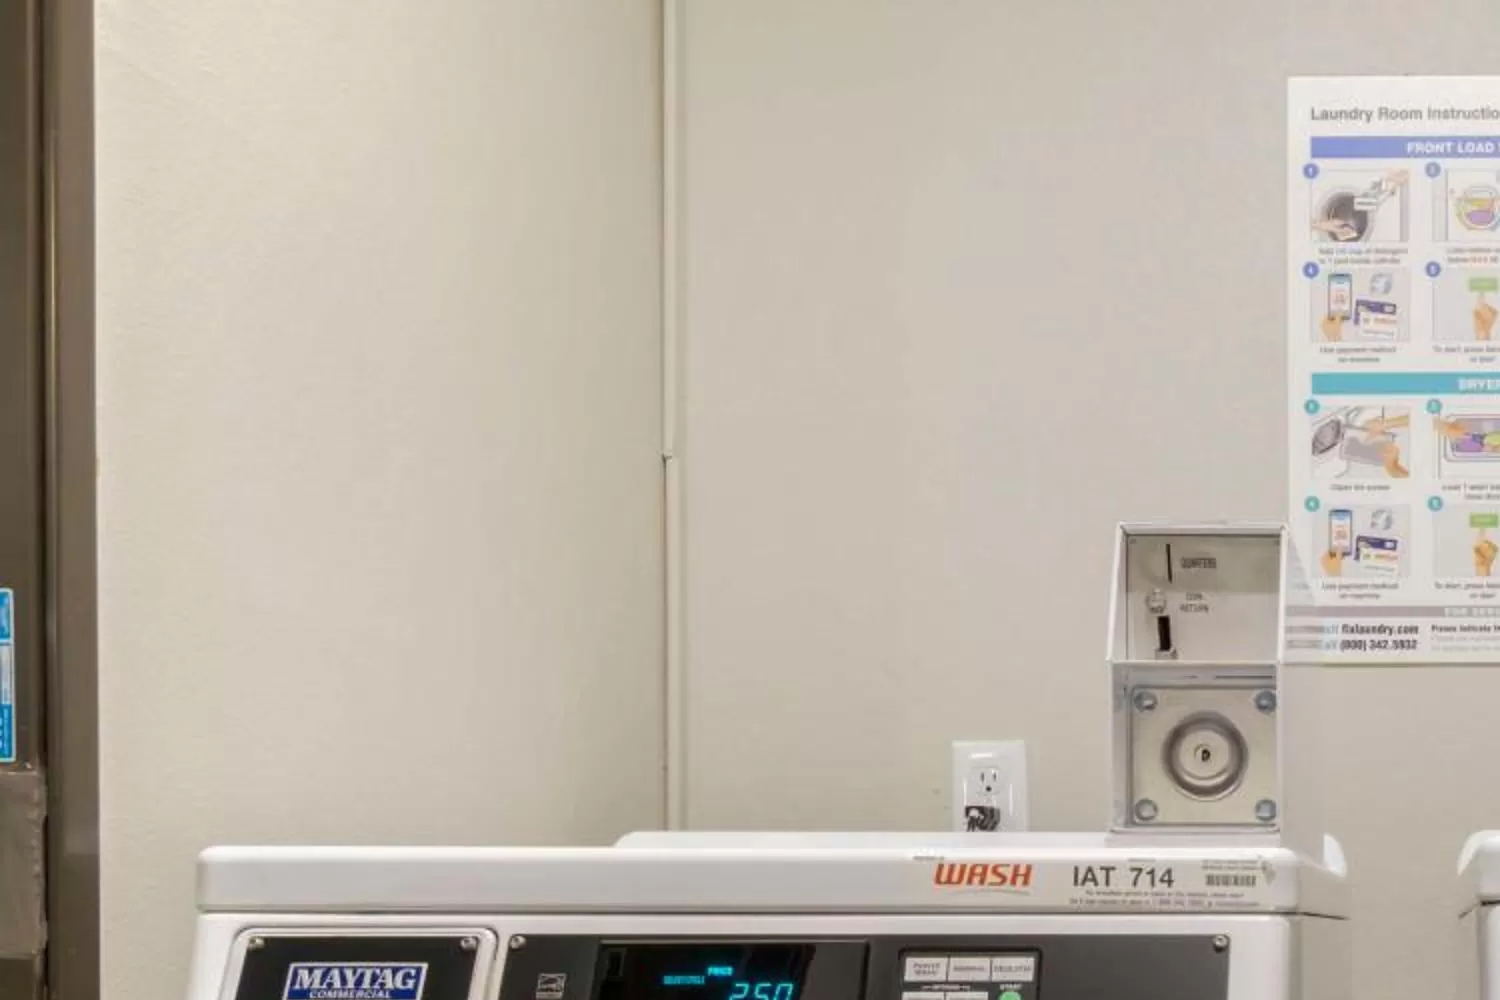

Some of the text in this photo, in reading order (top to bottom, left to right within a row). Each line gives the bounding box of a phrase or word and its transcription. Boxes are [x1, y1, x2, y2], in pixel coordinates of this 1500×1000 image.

[1310, 106, 1372, 123] Laundry
[1377, 107, 1424, 121] Room
[1406, 141, 1454, 154] FRONT
[1457, 141, 1495, 154] LOAD
[933, 862, 1175, 889] WASH IAT 714
[293, 966, 418, 990] MAYTAG
[308, 988, 391, 1000] COMMERCIAL
